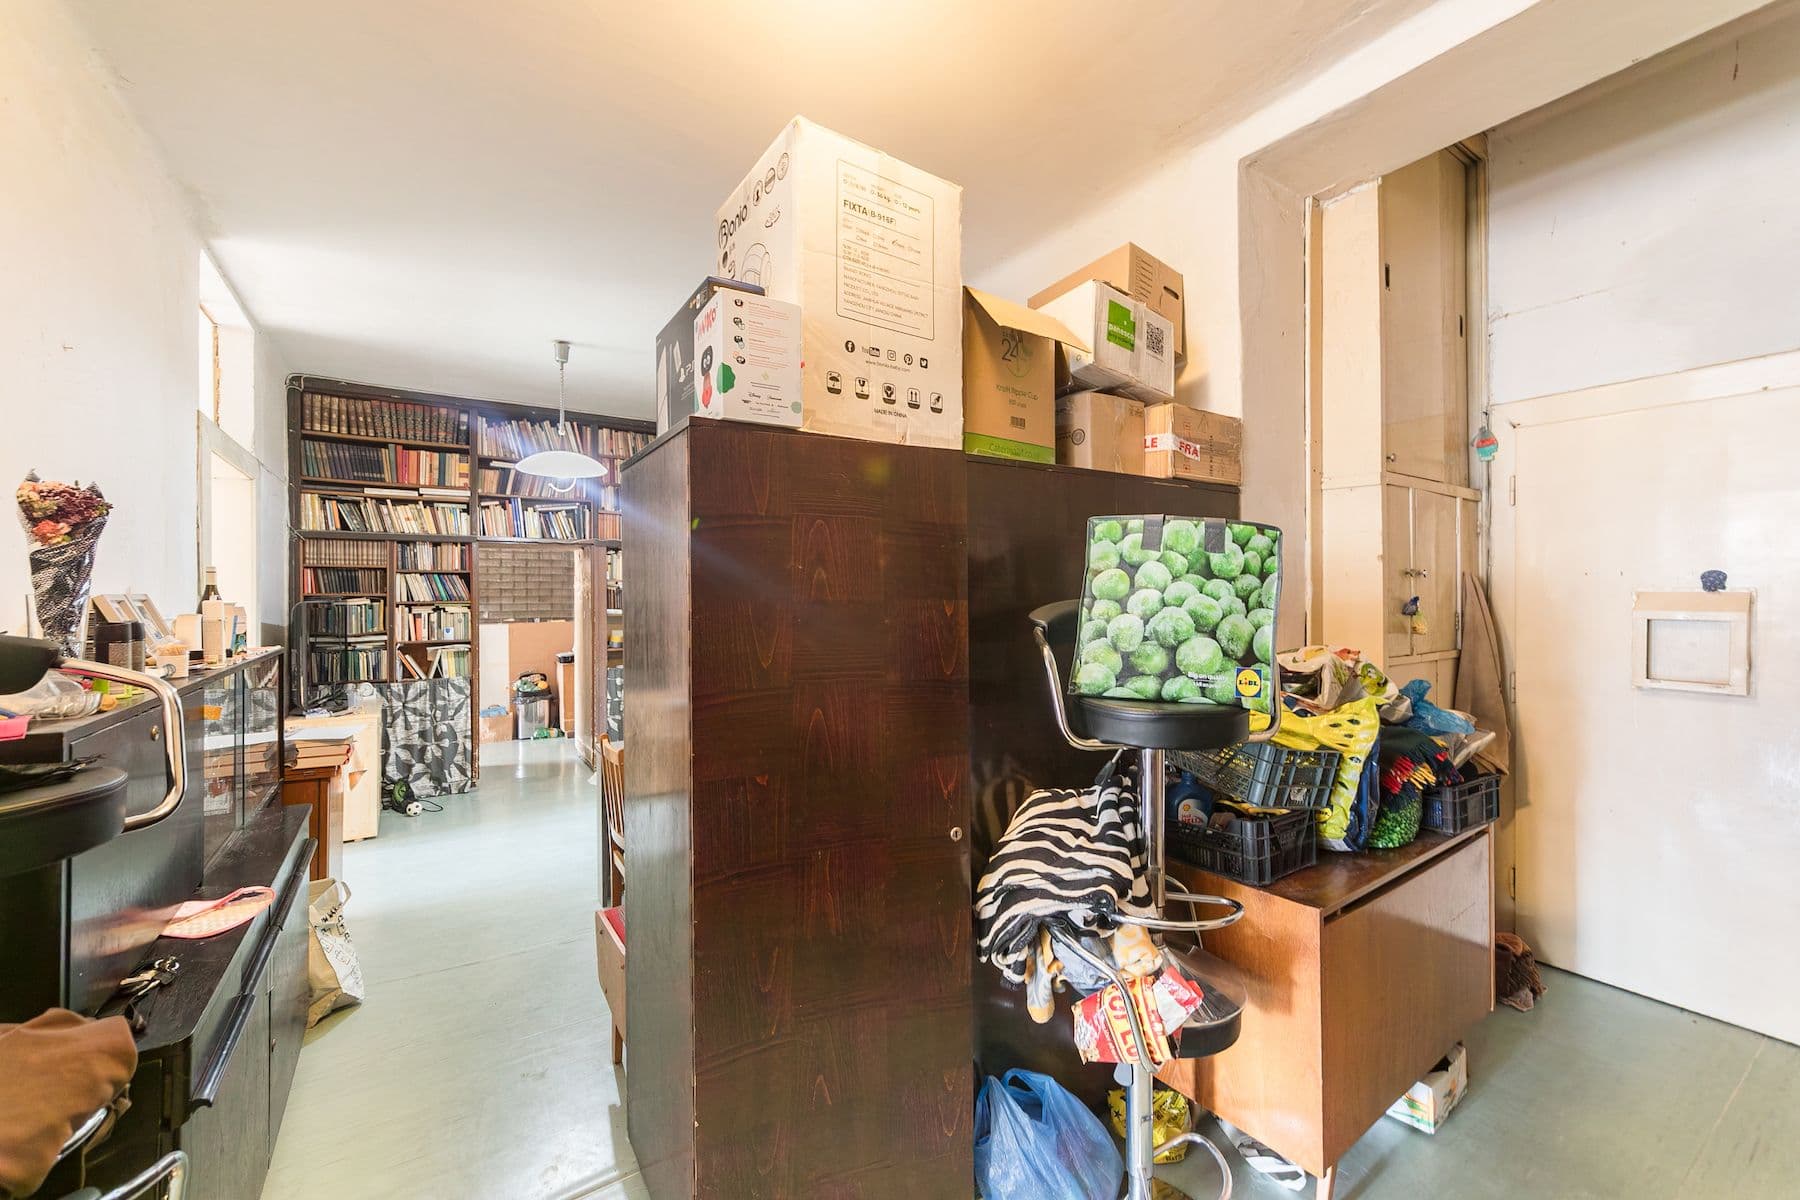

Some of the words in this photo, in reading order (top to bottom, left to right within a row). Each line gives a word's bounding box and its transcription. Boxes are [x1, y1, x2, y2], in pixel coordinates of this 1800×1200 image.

[843, 199, 868, 216] FIXTA
[1001, 338, 1020, 362] 24
[1178, 440, 1199, 457] FRA
